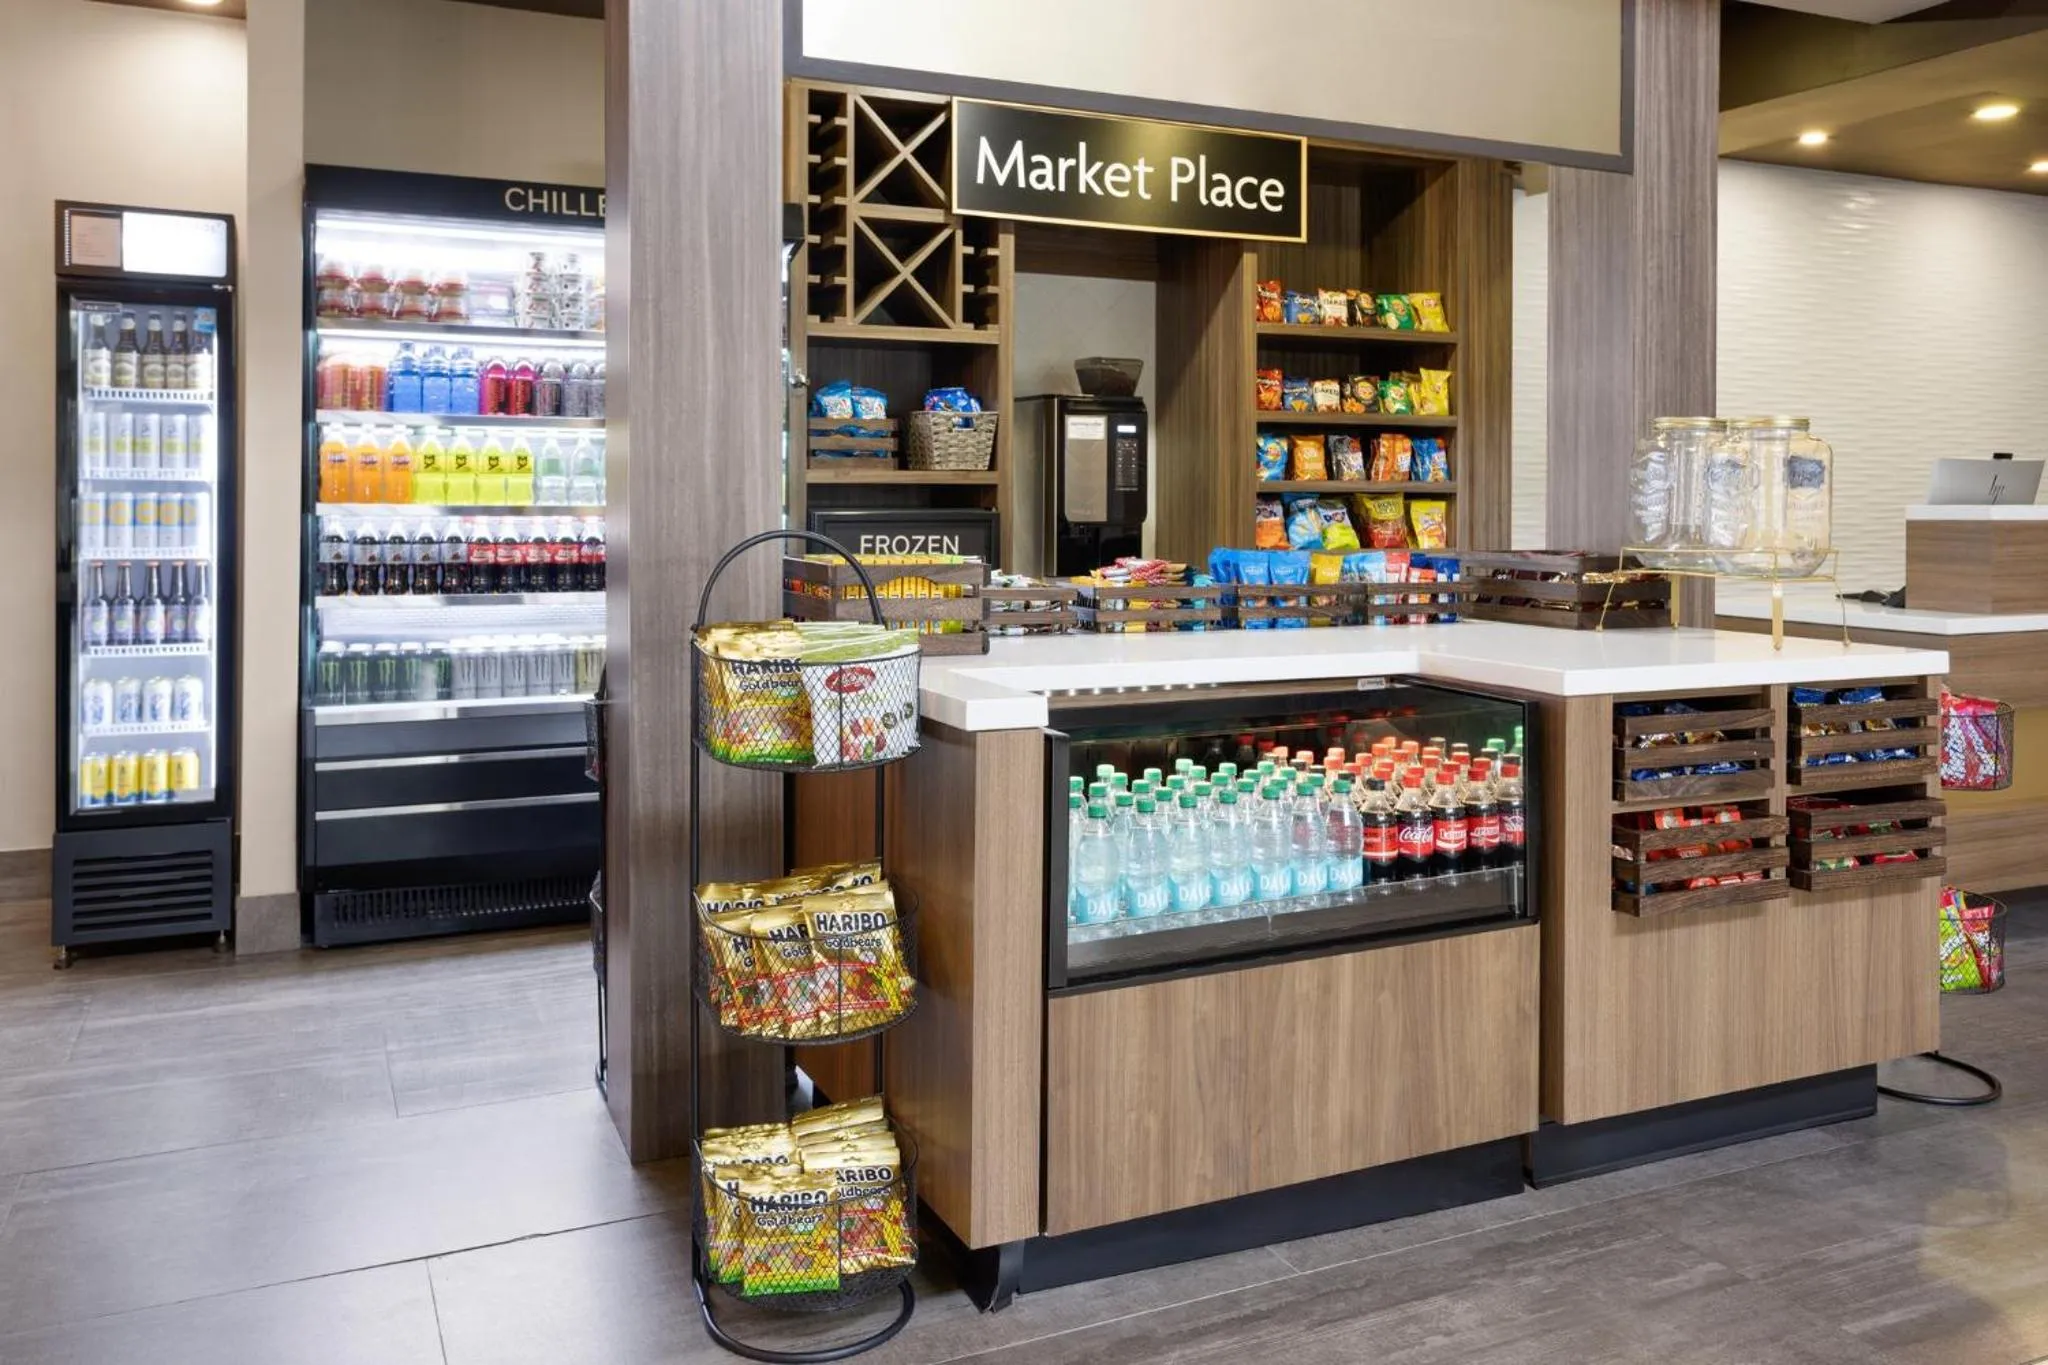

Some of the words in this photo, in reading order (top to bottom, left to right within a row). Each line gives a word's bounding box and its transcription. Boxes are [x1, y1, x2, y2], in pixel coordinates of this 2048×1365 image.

[975, 135, 1155, 200] Market
[1170, 154, 1286, 213] Place
[859, 535, 960, 555] FROZEN
[815, 911, 887, 934] HARIBO
[768, 923, 809, 944] HAR
[782, 945, 813, 959] Gold
[836, 1167, 893, 1184] ARIBO
[750, 1190, 829, 1213] HARIBO
